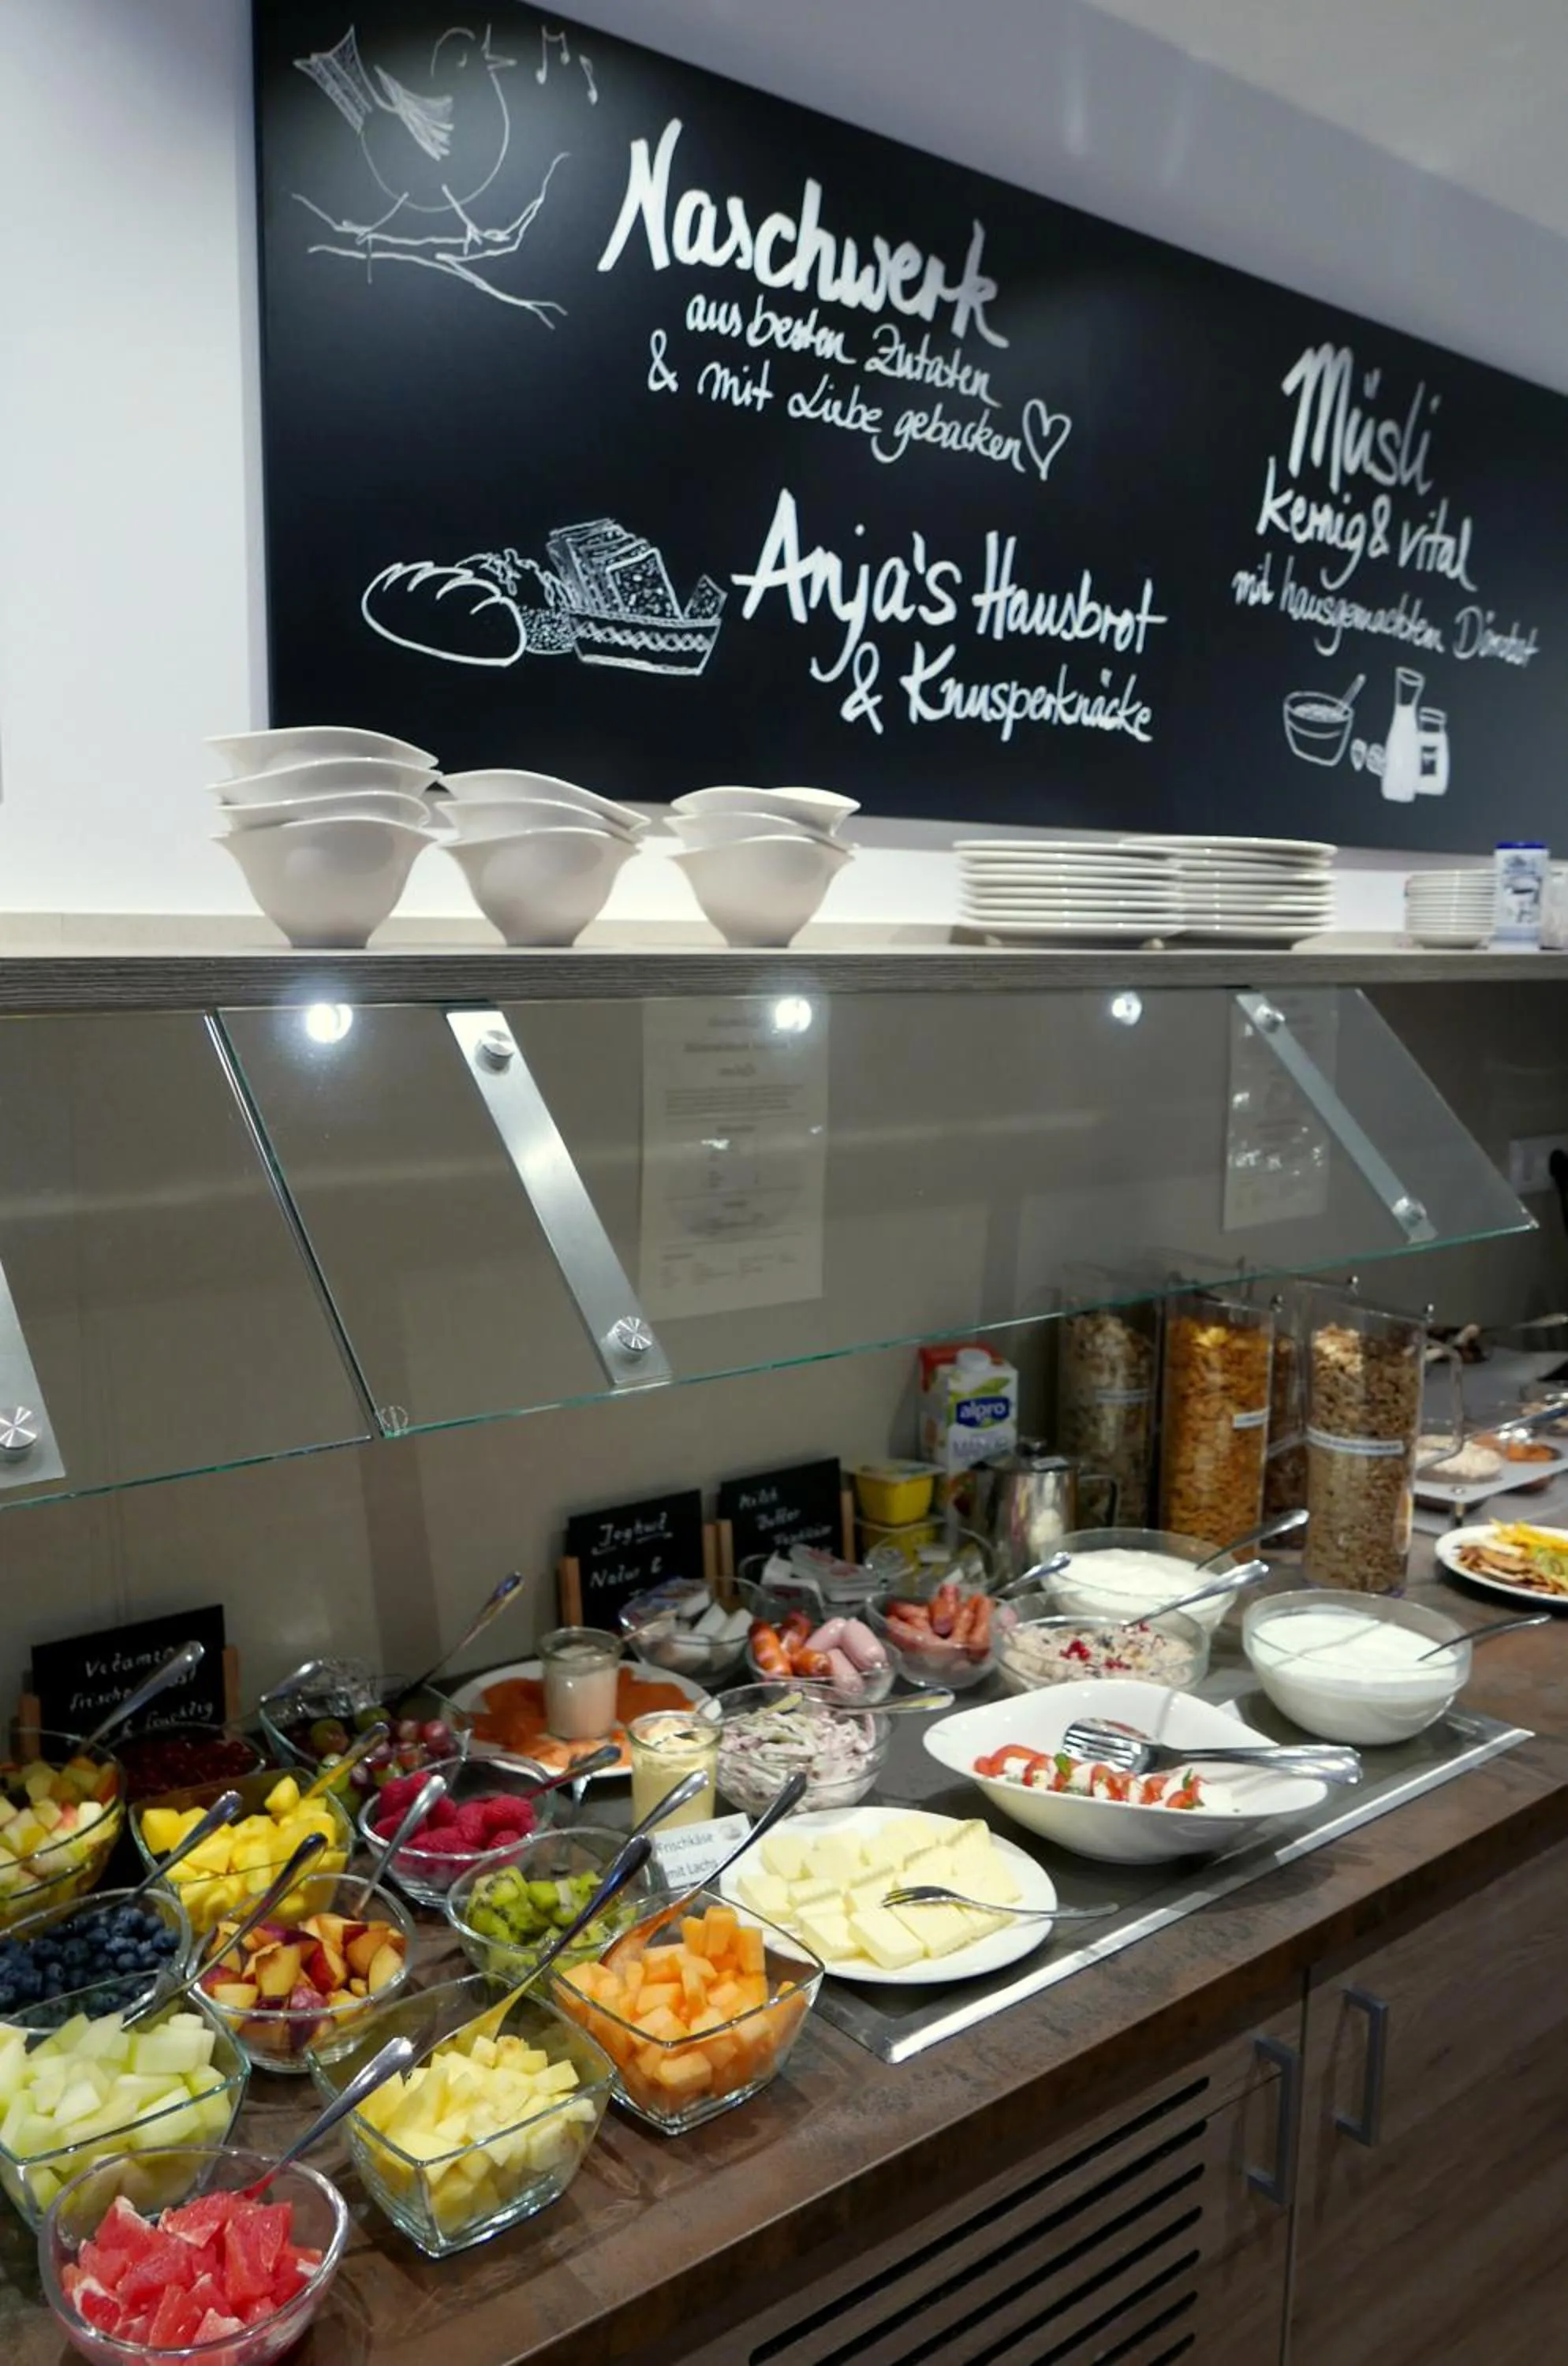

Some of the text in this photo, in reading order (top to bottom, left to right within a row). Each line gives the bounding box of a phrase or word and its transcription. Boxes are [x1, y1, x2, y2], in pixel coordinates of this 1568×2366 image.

[598, 118, 1010, 349] Naschwerk
[648, 330, 1025, 472] & mit Liebe gebacken
[686, 294, 1002, 408] aus besten Zutaten
[1281, 341, 1442, 495] Müsli
[730, 487, 1167, 683] Anja's Hausbrot
[1398, 498, 1478, 592] vital
[841, 640, 1153, 742] & Knusperknäcke
[959, 1399, 1006, 1420] alpro
